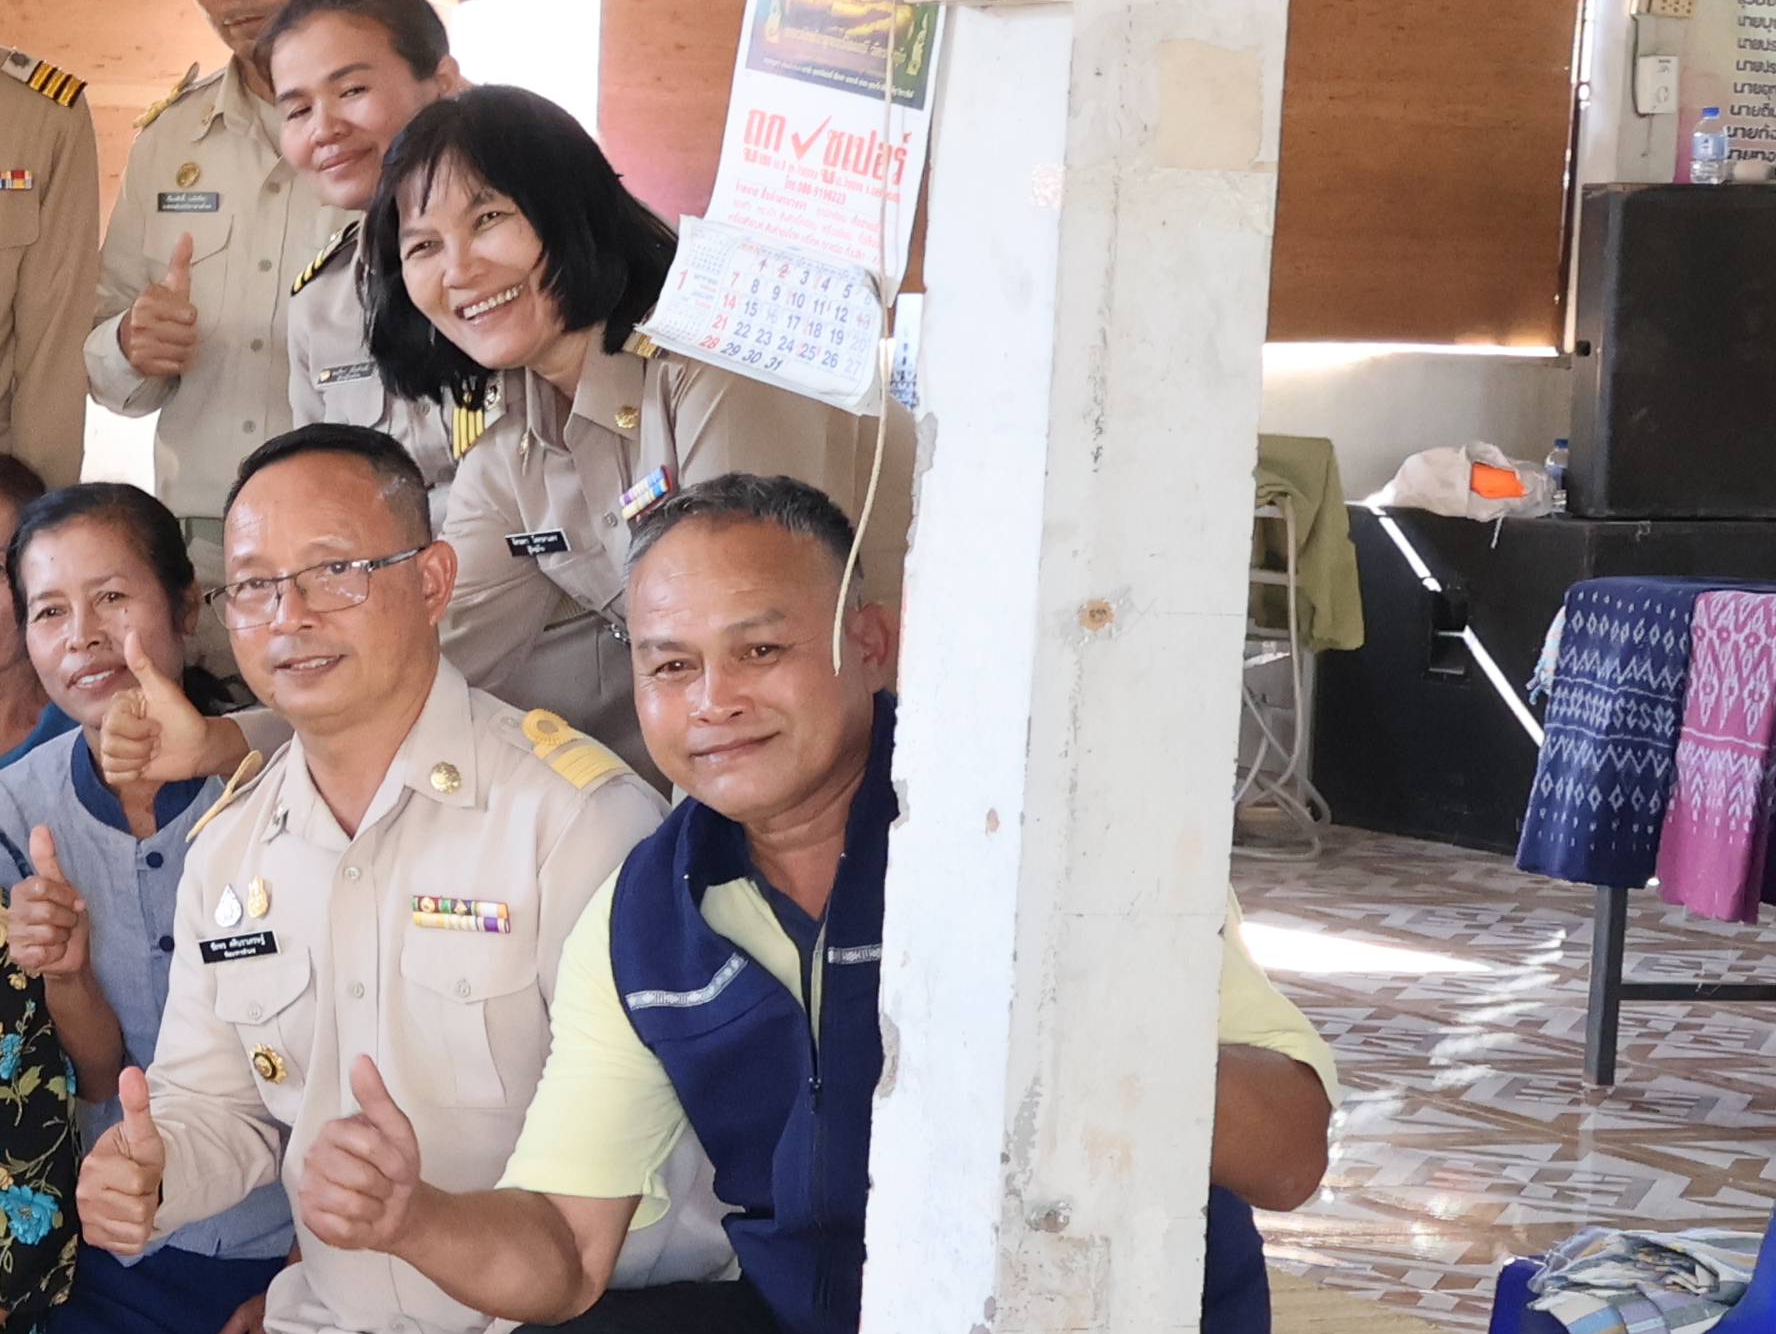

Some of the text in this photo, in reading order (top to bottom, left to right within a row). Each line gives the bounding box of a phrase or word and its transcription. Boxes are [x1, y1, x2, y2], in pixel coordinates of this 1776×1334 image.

[751, 279, 760, 294] 8
[771, 286, 781, 300] 9
[791, 292, 805, 308] 10
[813, 299, 826, 315] 11
[834, 305, 848, 323] 12
[778, 264, 790, 279] 2
[800, 270, 810, 285] 3
[821, 276, 831, 292] 4
[842, 283, 853, 299] 5
[723, 293, 737, 310] 14
[744, 300, 758, 317] 15
[787, 314, 801, 330] 17
[808, 322, 823, 339] 18
[830, 328, 844, 345] 19
[700, 335, 783, 372] 28 29 30 31
[712, 314, 728, 331] 21
[734, 321, 751, 339] 22
[755, 328, 772, 346] 23
[778, 335, 795, 354] 24
[800, 343, 816, 361] 25
[822, 351, 838, 369] 26
